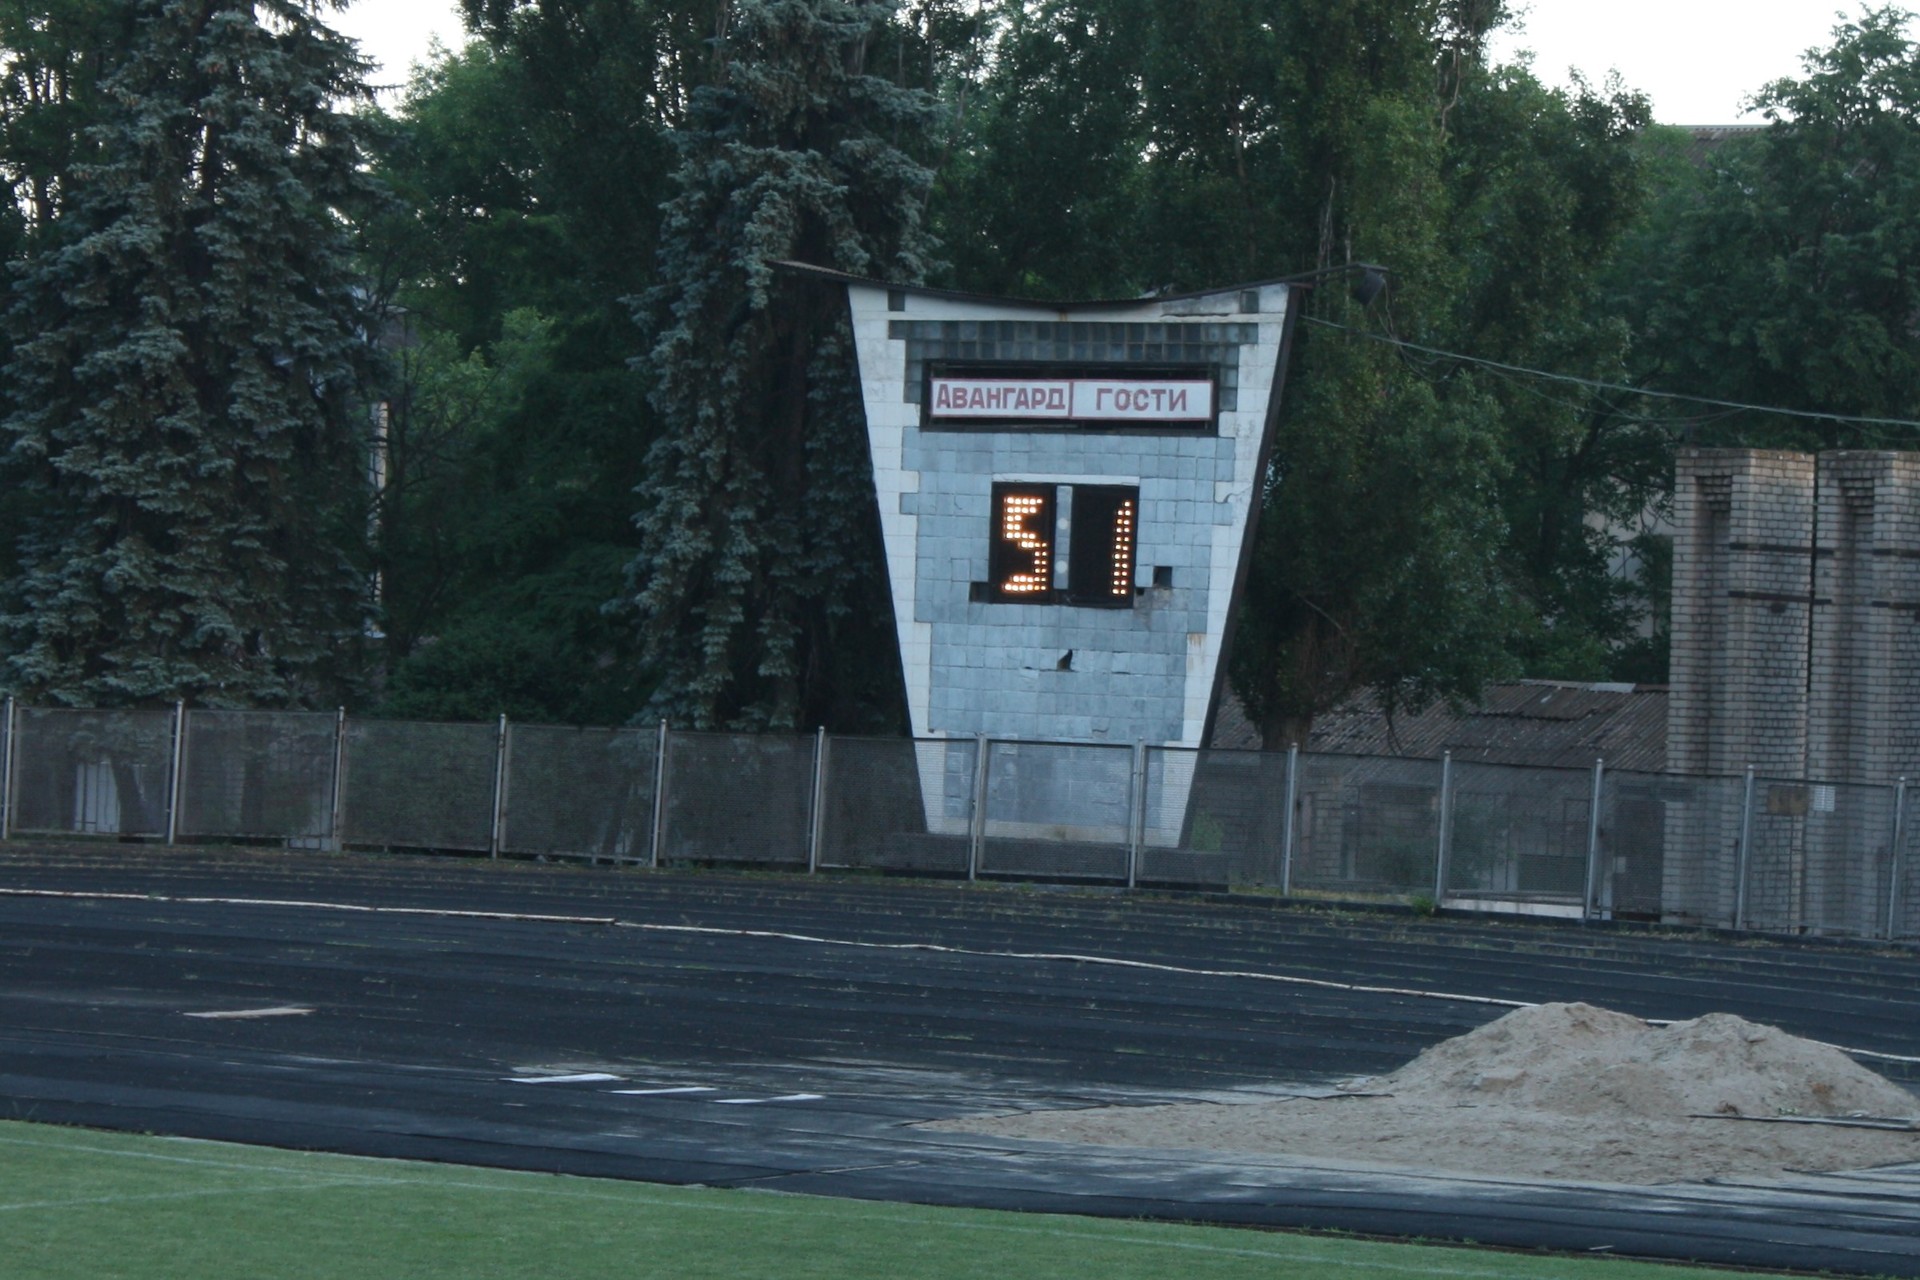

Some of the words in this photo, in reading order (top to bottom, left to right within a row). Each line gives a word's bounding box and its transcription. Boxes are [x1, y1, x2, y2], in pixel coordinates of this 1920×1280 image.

[936, 384, 1066, 410] АВАНГАРД
[1096, 387, 1187, 412] ГОСТИ
[1004, 497, 1047, 591] 5
[1112, 501, 1131, 595] 1
